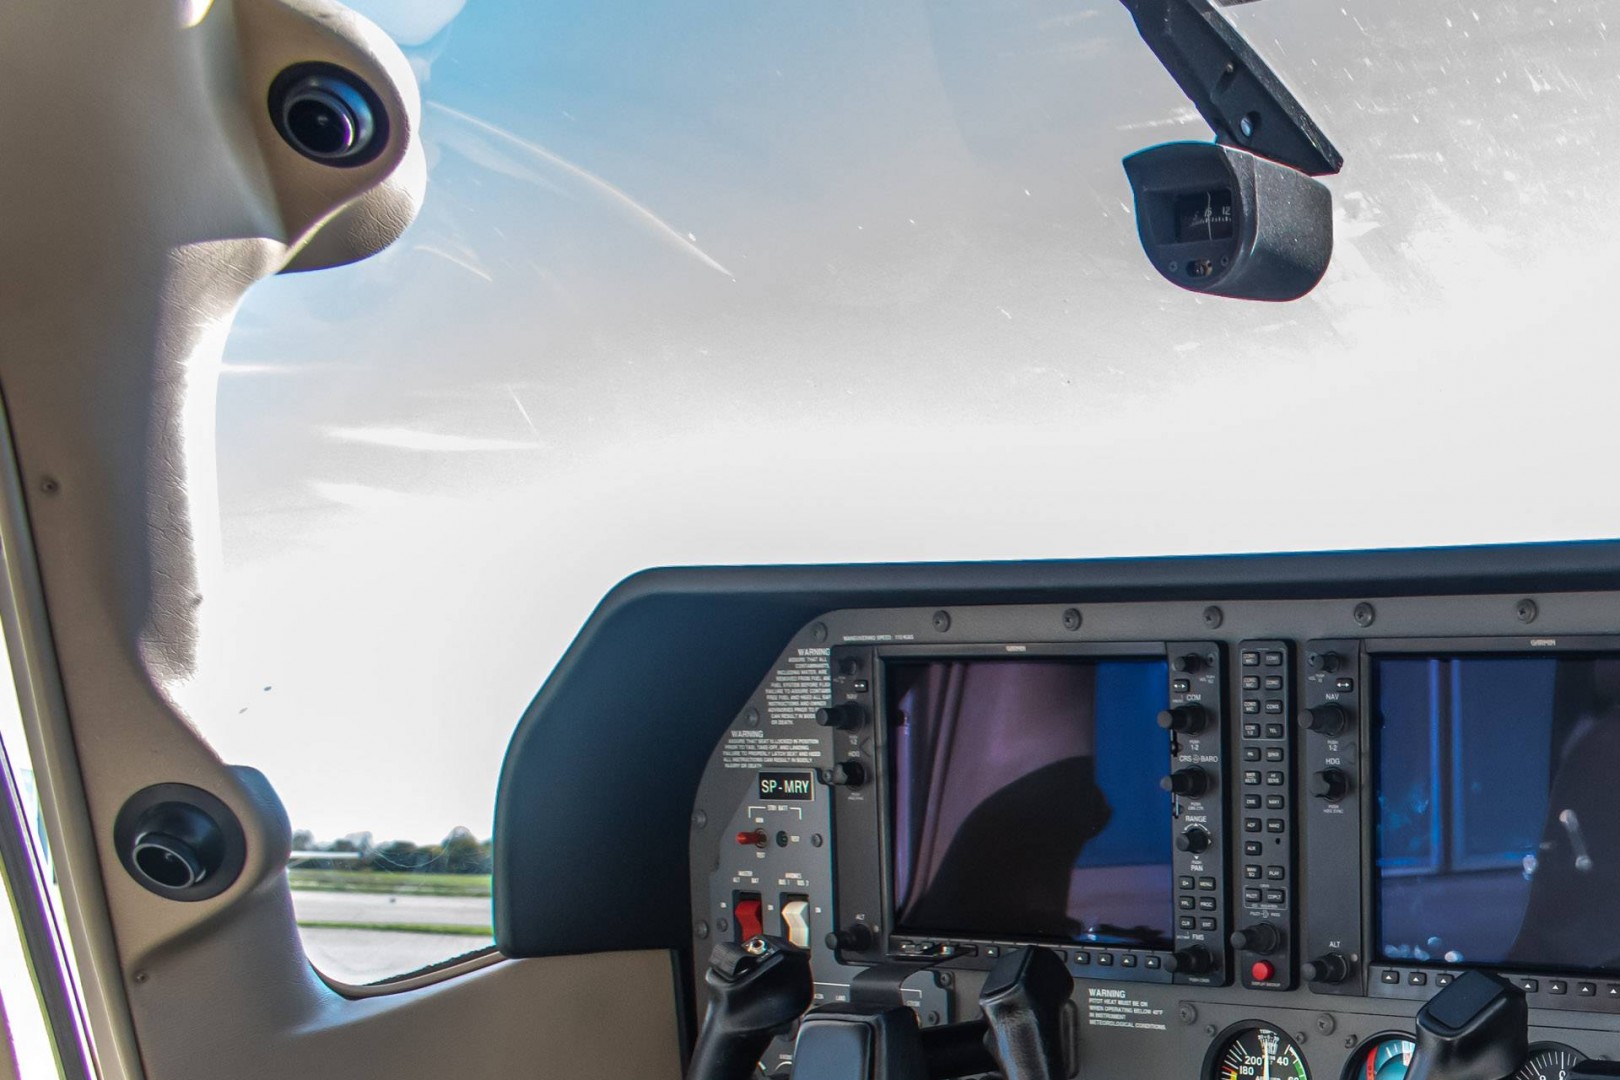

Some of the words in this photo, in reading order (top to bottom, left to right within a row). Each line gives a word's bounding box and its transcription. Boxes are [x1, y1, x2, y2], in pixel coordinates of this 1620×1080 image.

[1222, 206, 1231, 215] 12
[1200, 755, 1219, 763] BARO
[1325, 757, 1341, 765] HDG
[760, 779, 809, 793] SP-MRY
[1185, 815, 1207, 823] RANGE
[1190, 864, 1204, 872] PAN
[1088, 988, 1126, 998] WARNING
[1244, 1055, 1262, 1066] 200
[1276, 1056, 1289, 1066] 40
[1239, 1065, 1254, 1076] 180
